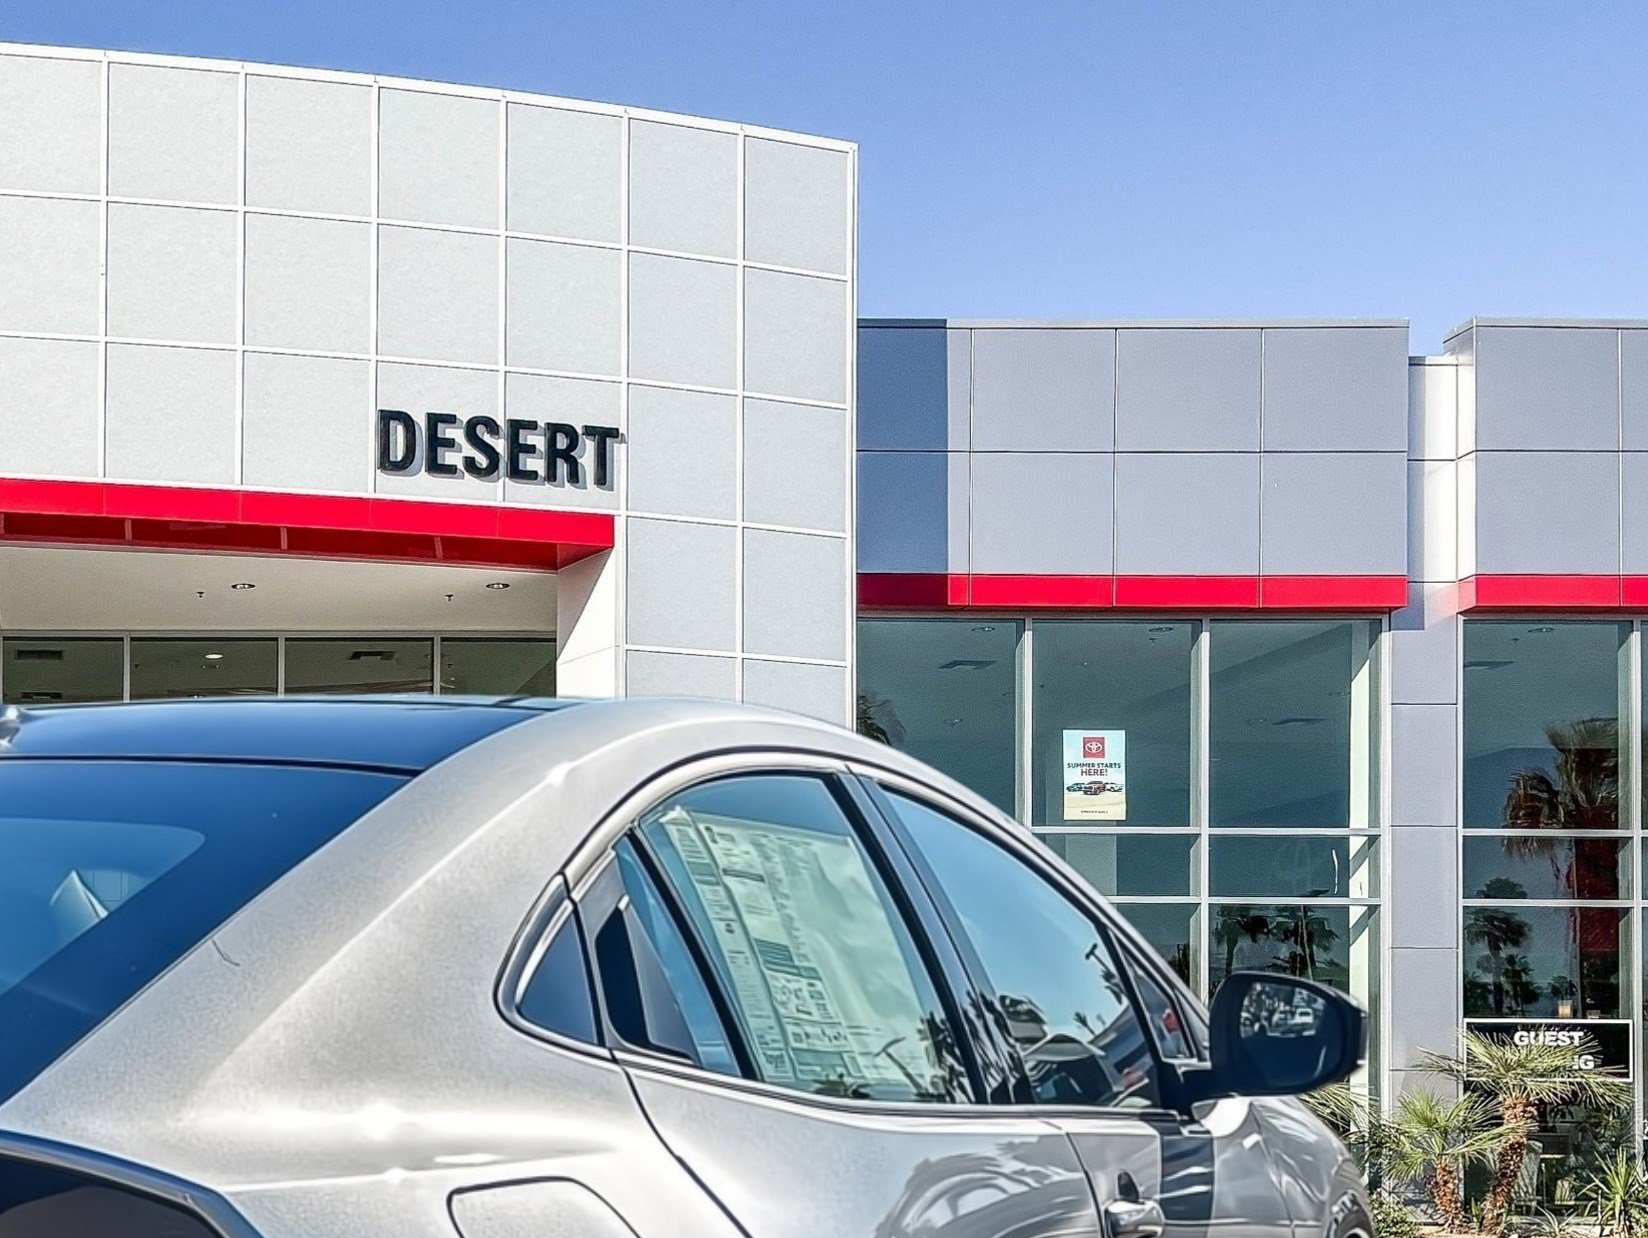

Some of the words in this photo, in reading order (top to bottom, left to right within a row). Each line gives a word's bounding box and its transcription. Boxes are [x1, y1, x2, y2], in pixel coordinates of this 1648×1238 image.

[376, 408, 621, 487] DESERT
[1081, 769, 1108, 777] HERE!
[1513, 1031, 1584, 1047] GUEST
